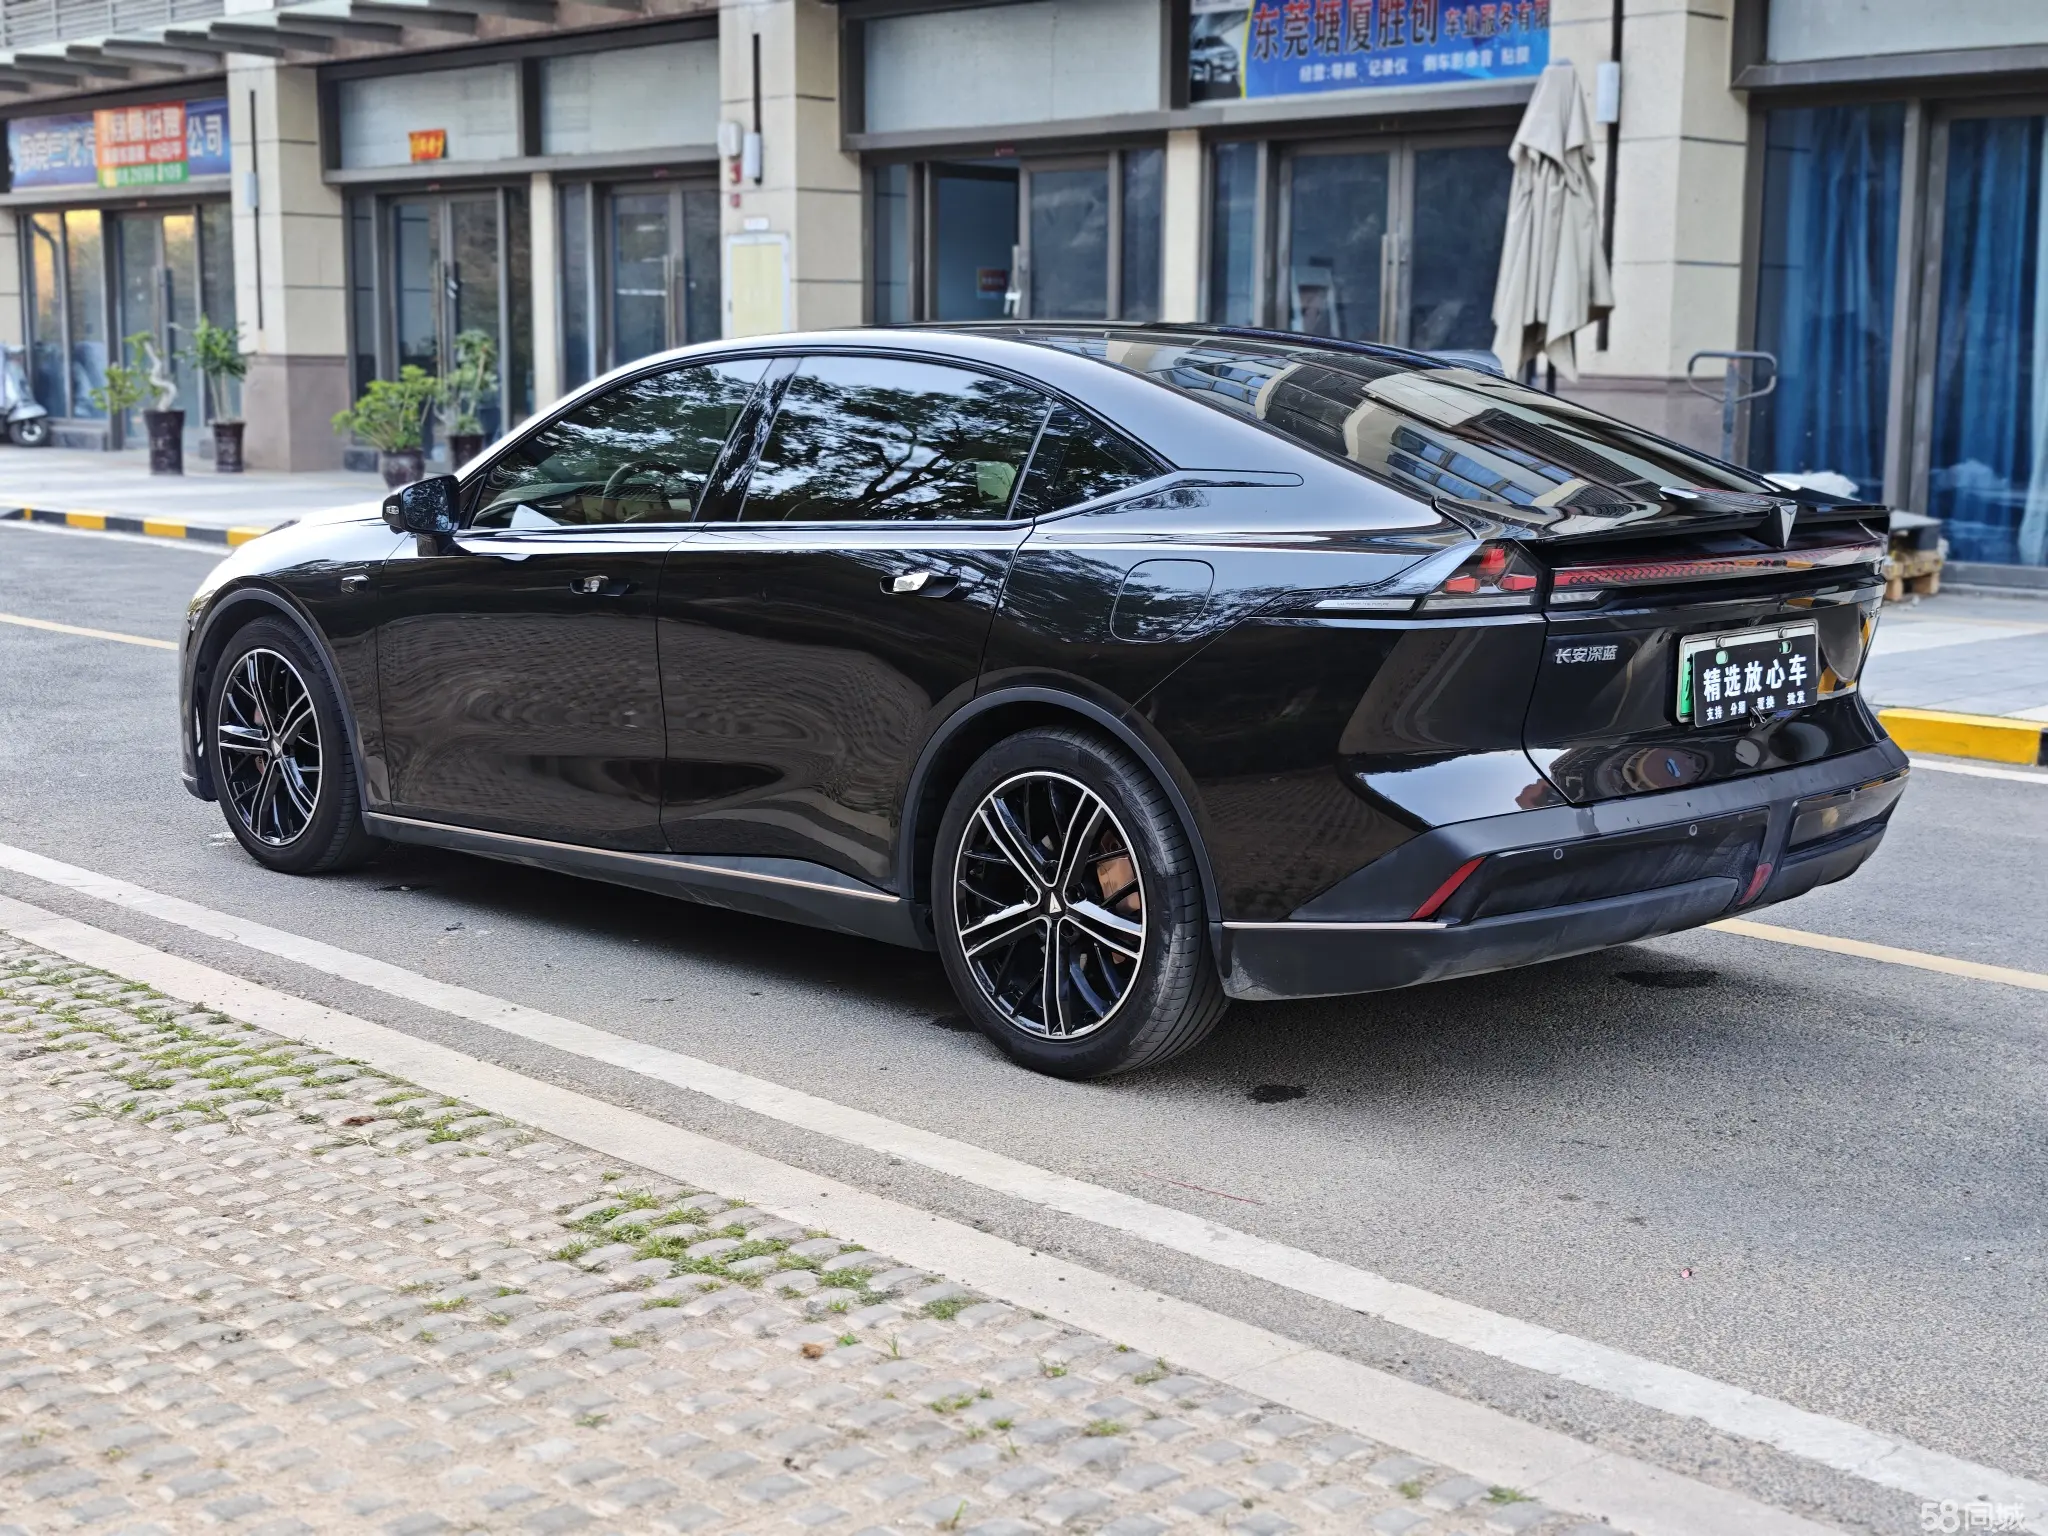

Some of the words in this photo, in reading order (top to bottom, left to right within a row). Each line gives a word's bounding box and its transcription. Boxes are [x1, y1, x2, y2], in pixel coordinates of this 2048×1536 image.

[1252, 0, 1438, 60] 东莞塘厦胜创
[1555, 645, 1618, 664] 长安深蓝
[1703, 654, 1808, 702] 精选放心车
[1706, 706, 1723, 721] 支持
[1730, 701, 1746, 716] 分期
